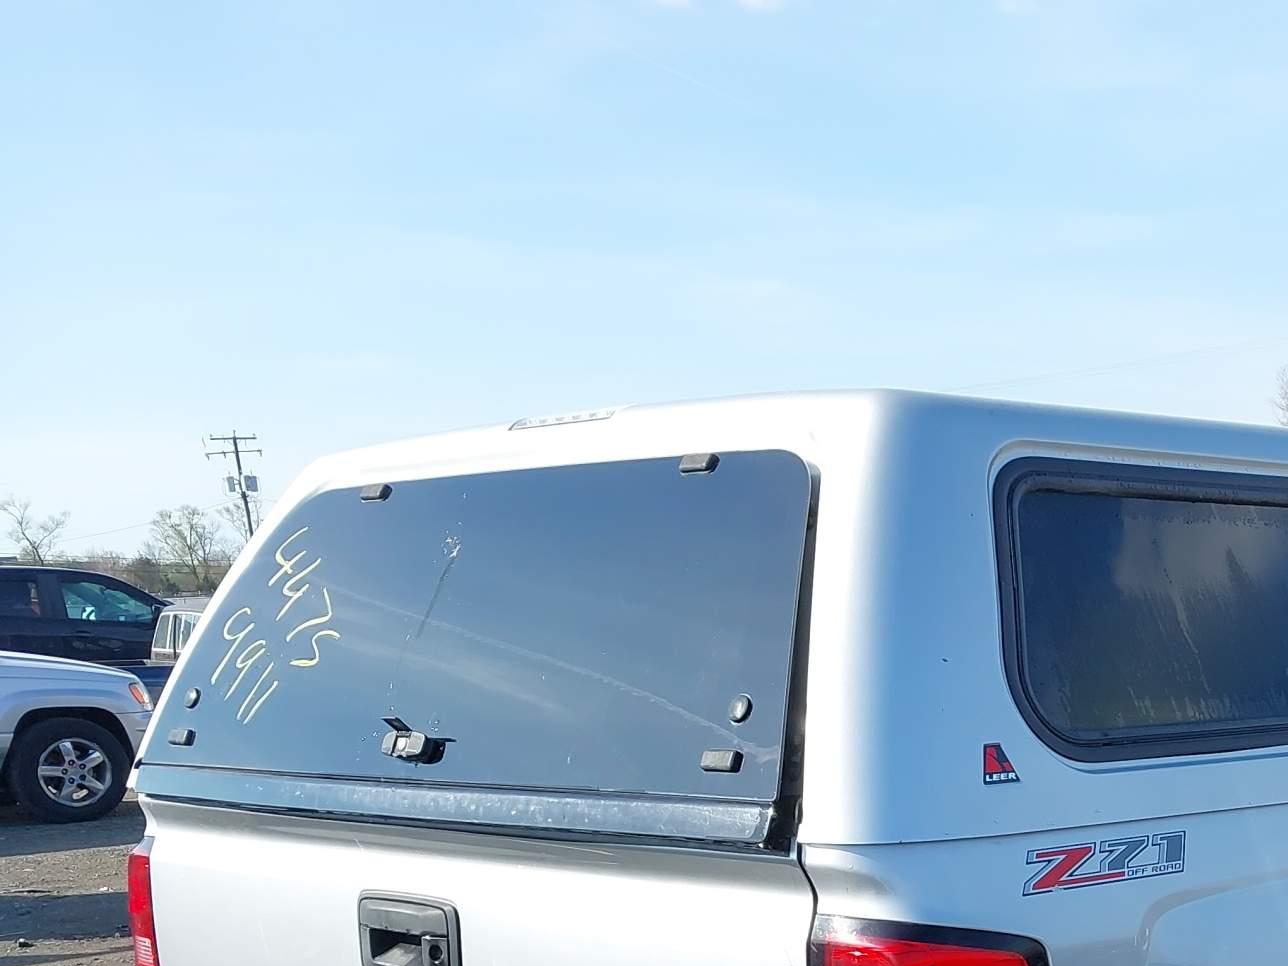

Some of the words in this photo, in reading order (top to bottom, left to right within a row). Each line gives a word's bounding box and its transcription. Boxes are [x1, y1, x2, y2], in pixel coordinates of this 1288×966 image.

[267, 526, 342, 668] 4475
[210, 607, 279, 725] 9911
[985, 772, 1018, 782] LEER
[1022, 830, 1187, 897] Z71
[1127, 867, 1151, 877] OFF
[1151, 862, 1183, 873] ROAD
